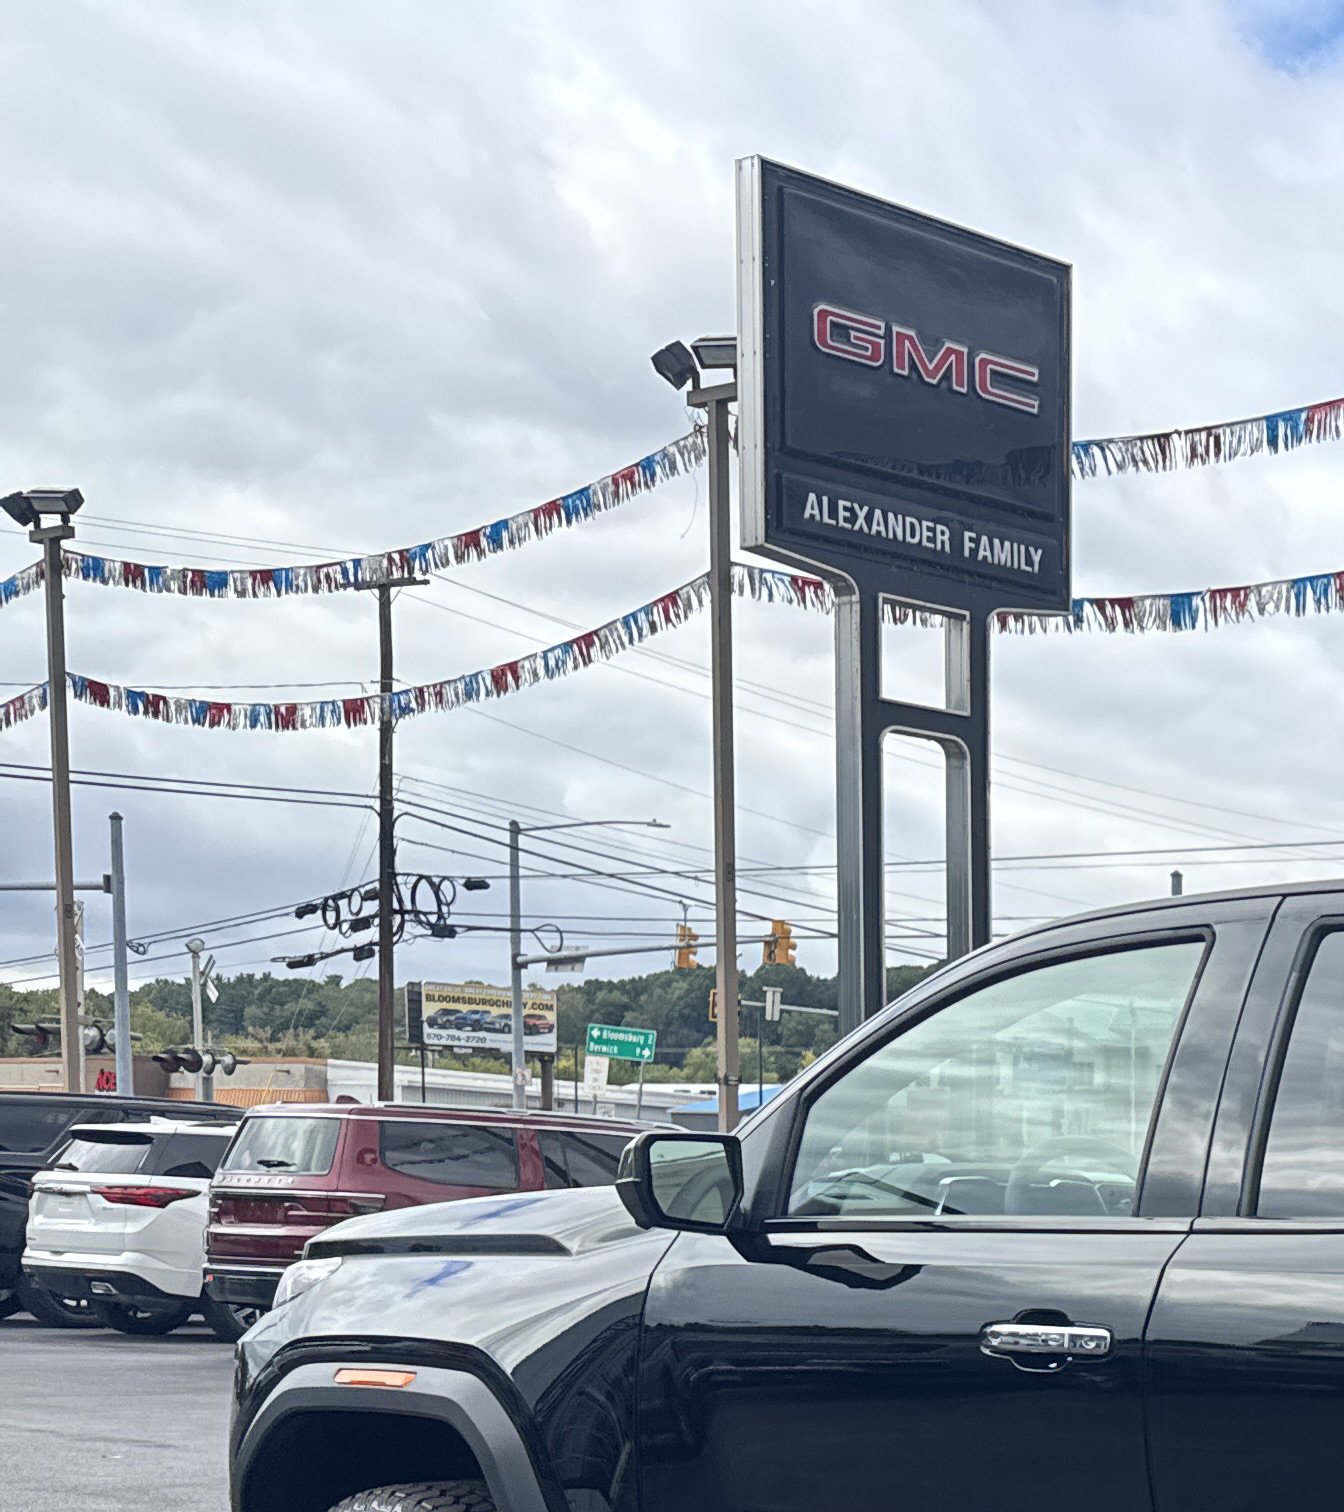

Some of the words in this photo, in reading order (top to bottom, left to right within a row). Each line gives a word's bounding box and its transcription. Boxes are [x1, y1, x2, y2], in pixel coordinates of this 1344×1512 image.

[813, 304, 1040, 415] GMC
[803, 491, 951, 554] ALEXANDER
[963, 532, 1044, 575] FAMILY
